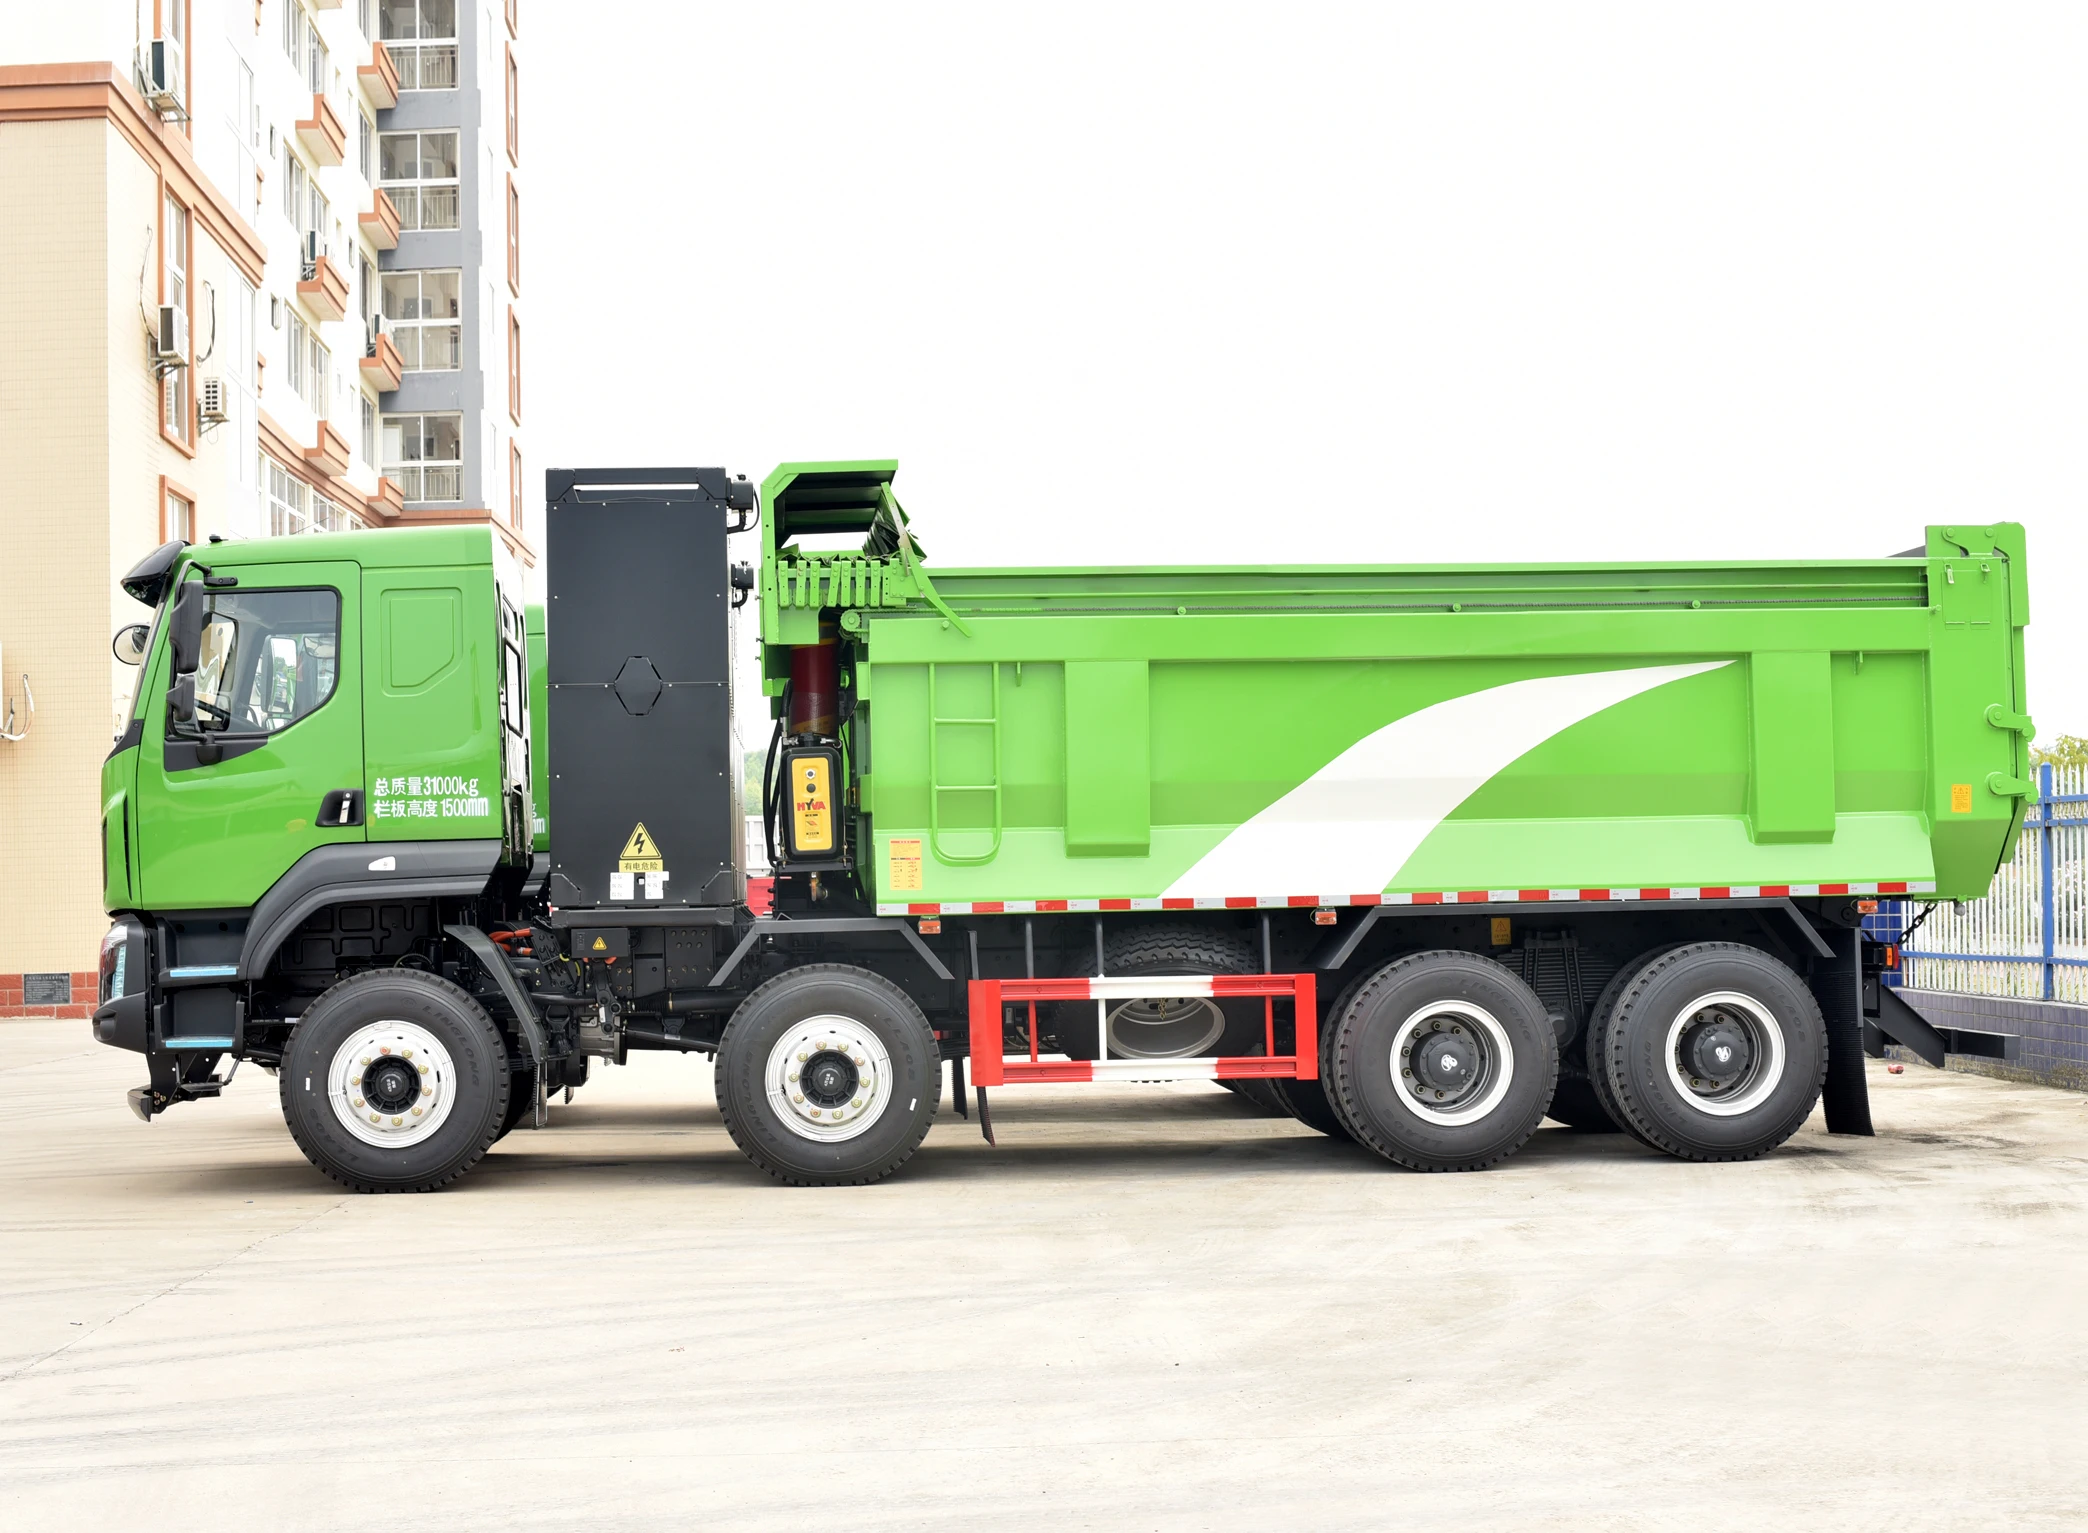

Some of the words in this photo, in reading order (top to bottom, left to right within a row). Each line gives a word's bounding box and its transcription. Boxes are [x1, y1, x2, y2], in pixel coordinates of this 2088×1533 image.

[374, 776, 479, 797] 总质量31000kg
[797, 798, 826, 811] HYVA
[624, 862, 658, 871] 有电危险
[422, 1005, 480, 1087] LINGLONG
[741, 1050, 778, 1144] LINGLONG
[1643, 1040, 1687, 1125] LINGLONG
